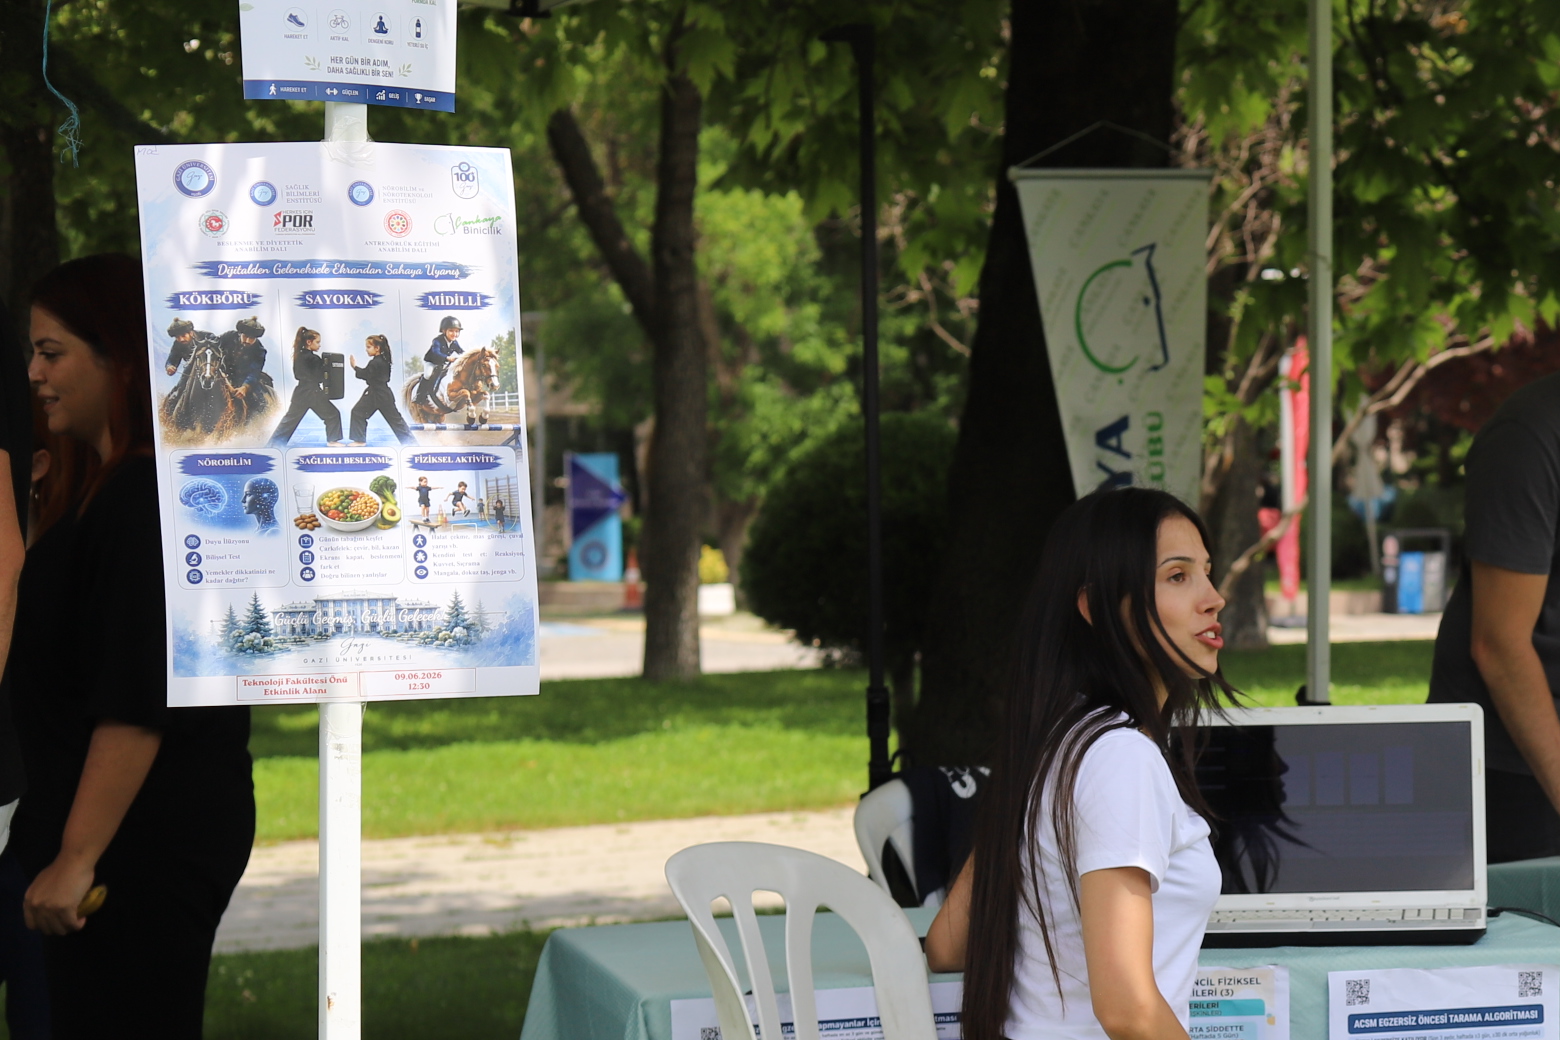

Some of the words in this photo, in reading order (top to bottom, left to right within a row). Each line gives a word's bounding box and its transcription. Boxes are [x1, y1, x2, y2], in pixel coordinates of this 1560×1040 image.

[330, 56, 344, 64] HER
[345, 55, 359, 65] GÜN
[360, 56, 371, 66] BİR
[372, 59, 390, 68] ADIM,
[327, 66, 344, 75] DAHA
[345, 65, 370, 76] SAĞLIKLI
[371, 67, 381, 77] BİR
[382, 69, 394, 78] SEN!
[342, 88, 358, 97] GÜÇLEN
[273, 211, 313, 228] SPOR
[463, 226, 502, 235] Binicilik
[217, 264, 270, 277] Dijitalden
[273, 264, 330, 275] Geleneksele
[332, 263, 383, 275] Ekrandan
[385, 264, 423, 278] Sahaya
[425, 264, 460, 278] Uyanış
[179, 291, 253, 305] KÖKBÖRÜ
[305, 294, 373, 305] SAYOKAN
[428, 293, 481, 306] MİDİLLİ
[197, 457, 251, 467] NÖROBİLİM
[299, 455, 341, 465] SAĞLIKLI
[343, 456, 390, 465] BESLENME
[414, 455, 454, 464] FİZİKSEL
[455, 454, 496, 464] AKTİVİTE
[205, 538, 221, 546] Duyu
[206, 553, 227, 562] Bilişsel
[275, 611, 309, 627] Güçlü
[361, 610, 396, 626] Güçlü
[335, 655, 413, 663] ÜNİVERSİTESİ
[242, 678, 284, 687] Teknoloji
[285, 677, 327, 685] Fakültesi
[329, 675, 348, 684] Önü
[394, 672, 442, 681] 09.06.2026
[264, 687, 301, 696] Etkinlik
[302, 686, 327, 694] Alanı
[408, 682, 430, 690] 12:30
[1218, 976, 1261, 985] FİZİKSEL
[1220, 988, 1234, 997] (3)
[1354, 1019, 1377, 1029] ACSM
[1378, 1014, 1417, 1028] EGZERSİZ
[1418, 1013, 1448, 1025] ÖNCESİ
[1449, 1013, 1482, 1024] TARAMA
[1484, 1009, 1538, 1022] ALGORİTMASI
[819, 1018, 866, 1031] apmayanlar
[1206, 1024, 1244, 1032] ŞİDDETTE
